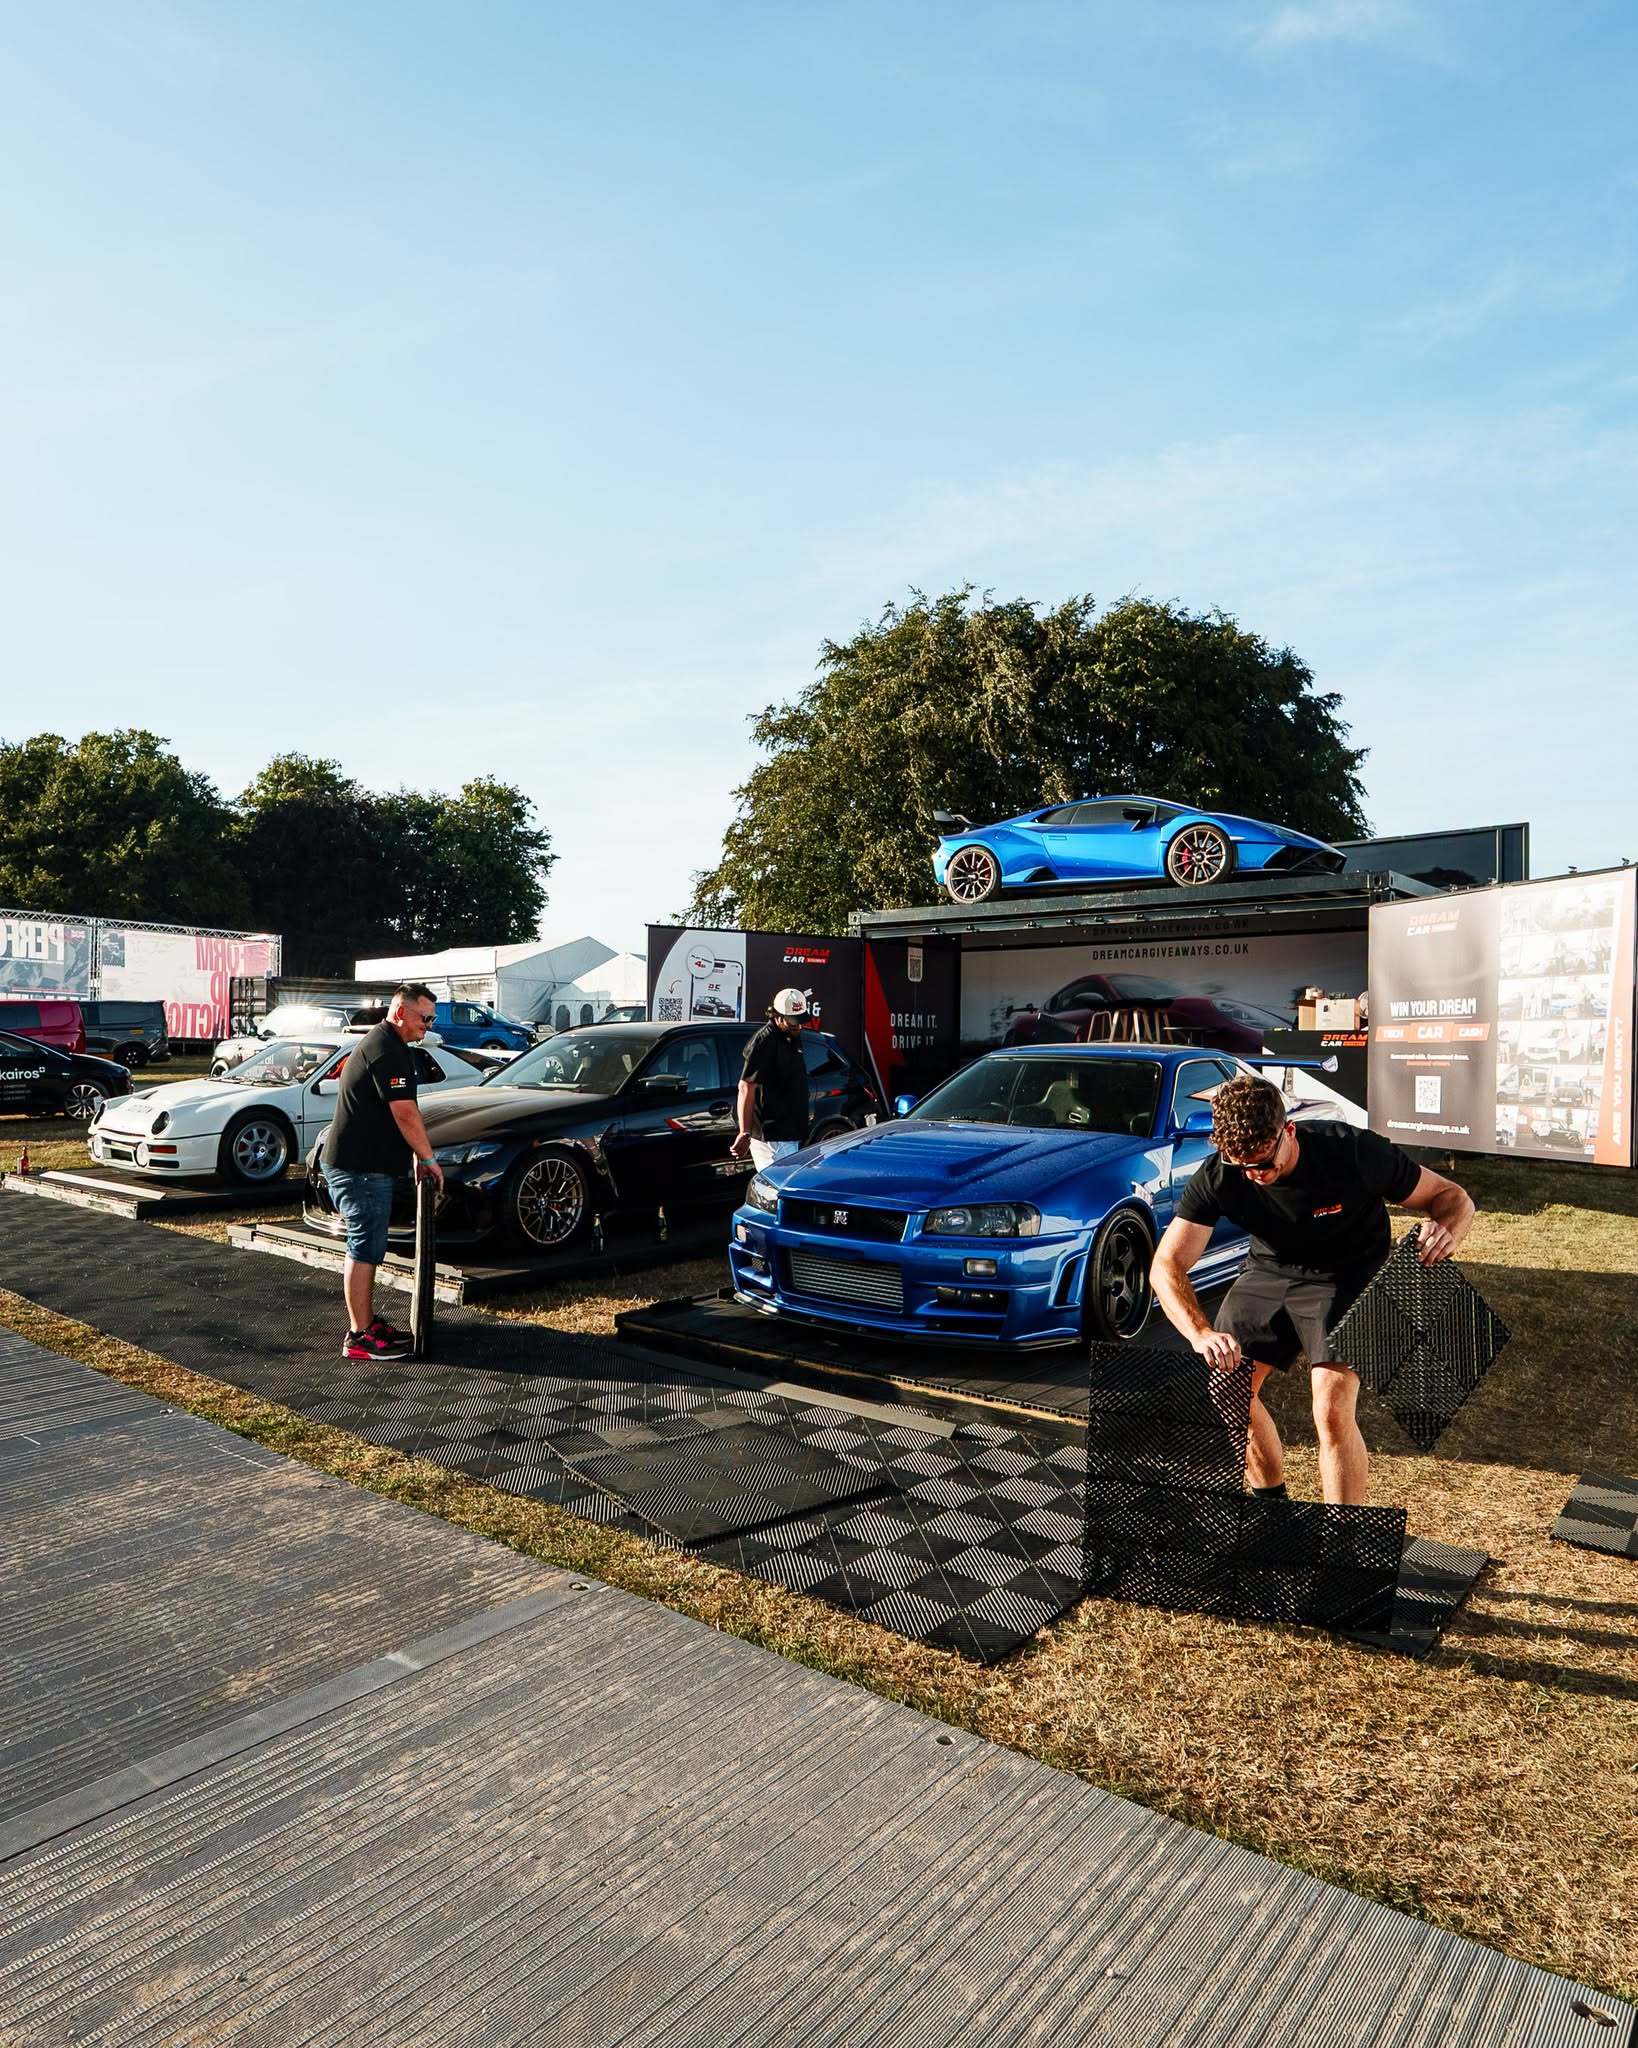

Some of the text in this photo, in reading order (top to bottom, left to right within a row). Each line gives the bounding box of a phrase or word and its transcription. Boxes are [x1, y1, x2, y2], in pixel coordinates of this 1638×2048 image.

[1092, 943, 1249, 960] DREAMCARGIVEAWAYS.CO.UK
[1390, 997, 1477, 1016] WIN YOUR DREAM
[890, 1013, 923, 1028] DREAM
[1417, 1026, 1444, 1039] CAR
[0, 1068, 40, 1080] kairos
